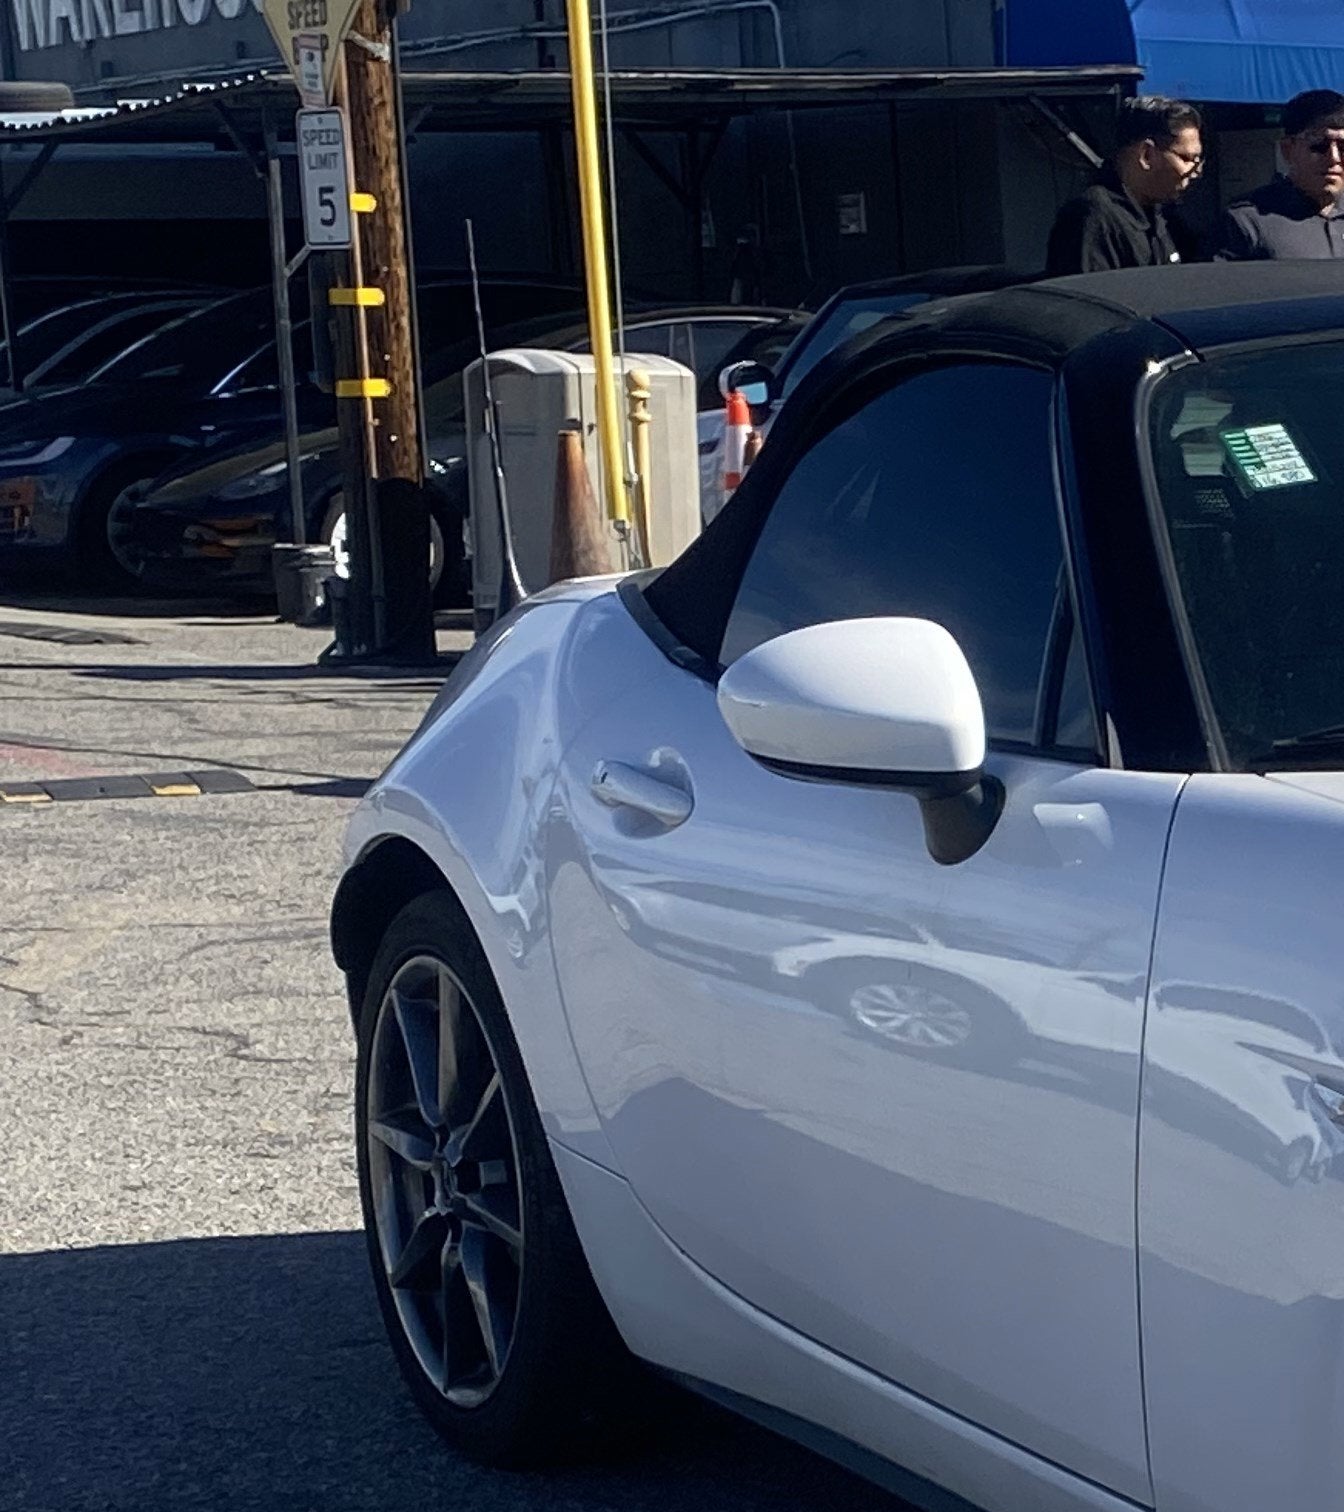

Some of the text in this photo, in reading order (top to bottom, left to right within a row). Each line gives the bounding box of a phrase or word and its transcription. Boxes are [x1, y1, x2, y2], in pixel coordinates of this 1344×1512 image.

[302, 128, 340, 146] SPEED
[307, 152, 338, 170] LIMIT
[319, 186, 336, 227] 5
